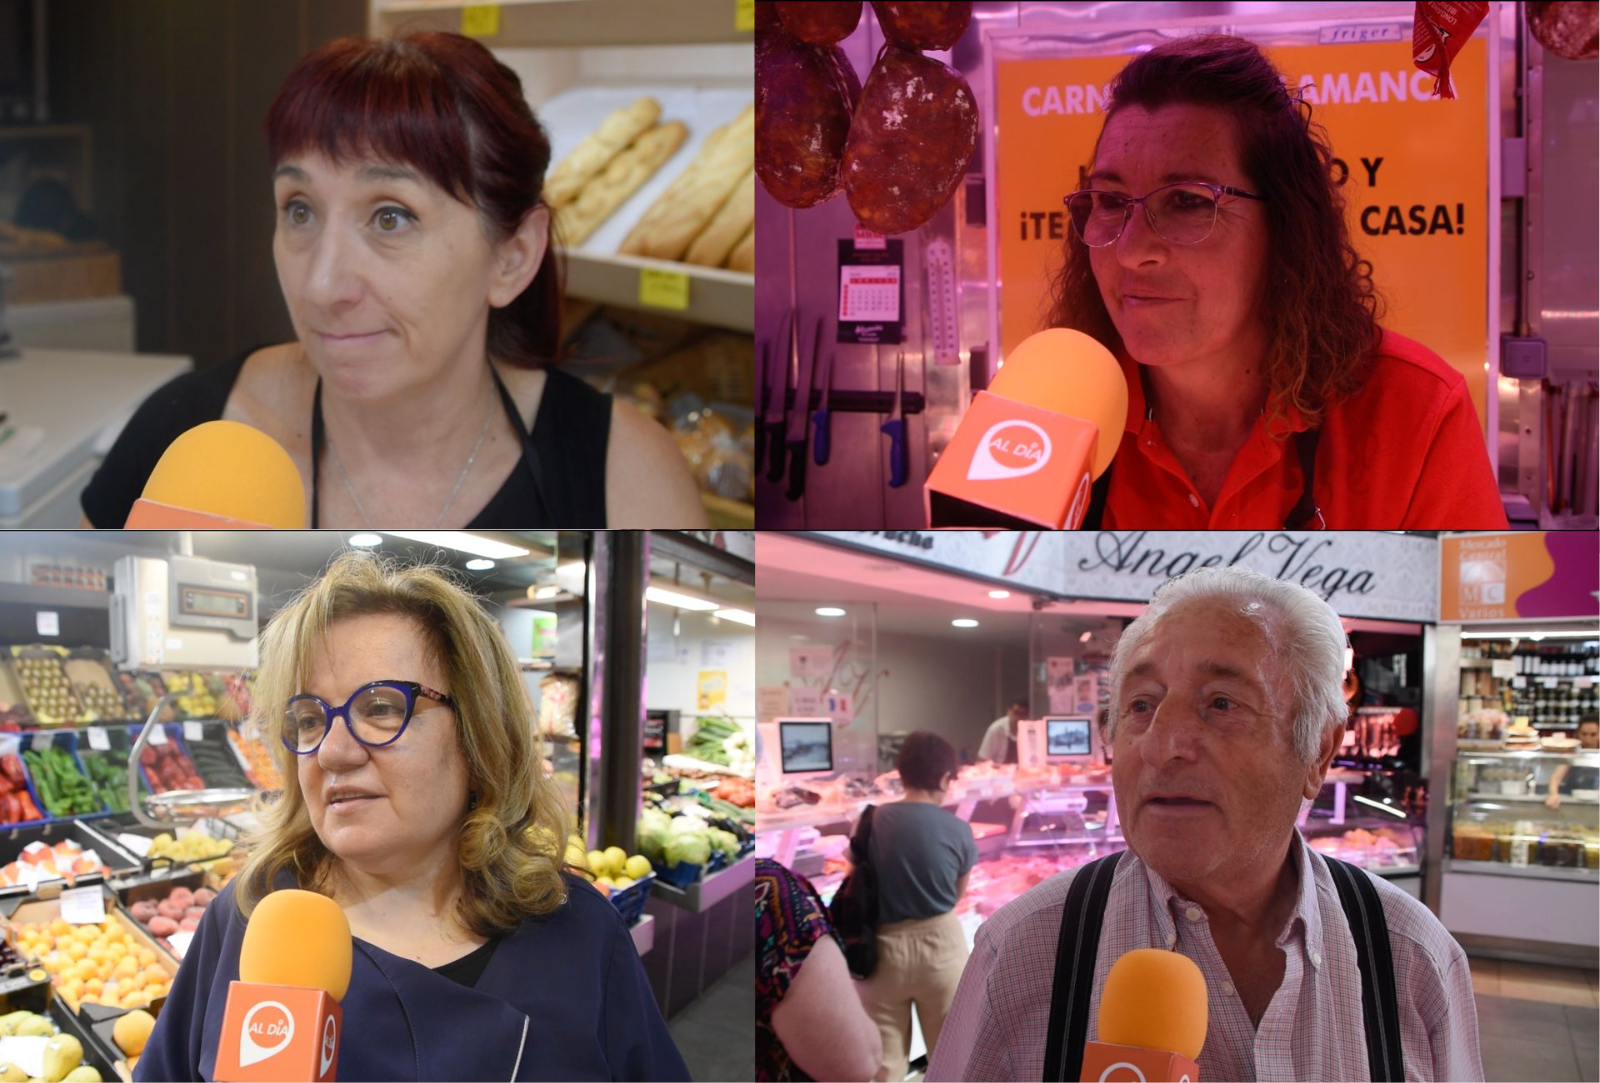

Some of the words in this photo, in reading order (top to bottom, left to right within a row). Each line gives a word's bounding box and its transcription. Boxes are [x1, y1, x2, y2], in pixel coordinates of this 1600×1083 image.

[1332, 27, 1390, 43] friger
[1360, 157, 1384, 187] Y
[1360, 203, 1465, 236] CASA!
[989, 438, 1010, 453] AL
[1460, 538, 1507, 550] Mercado
[1268, 533, 1377, 602] Vega
[1459, 606, 1505, 619] Varios
[249, 1022, 264, 1034] AL
